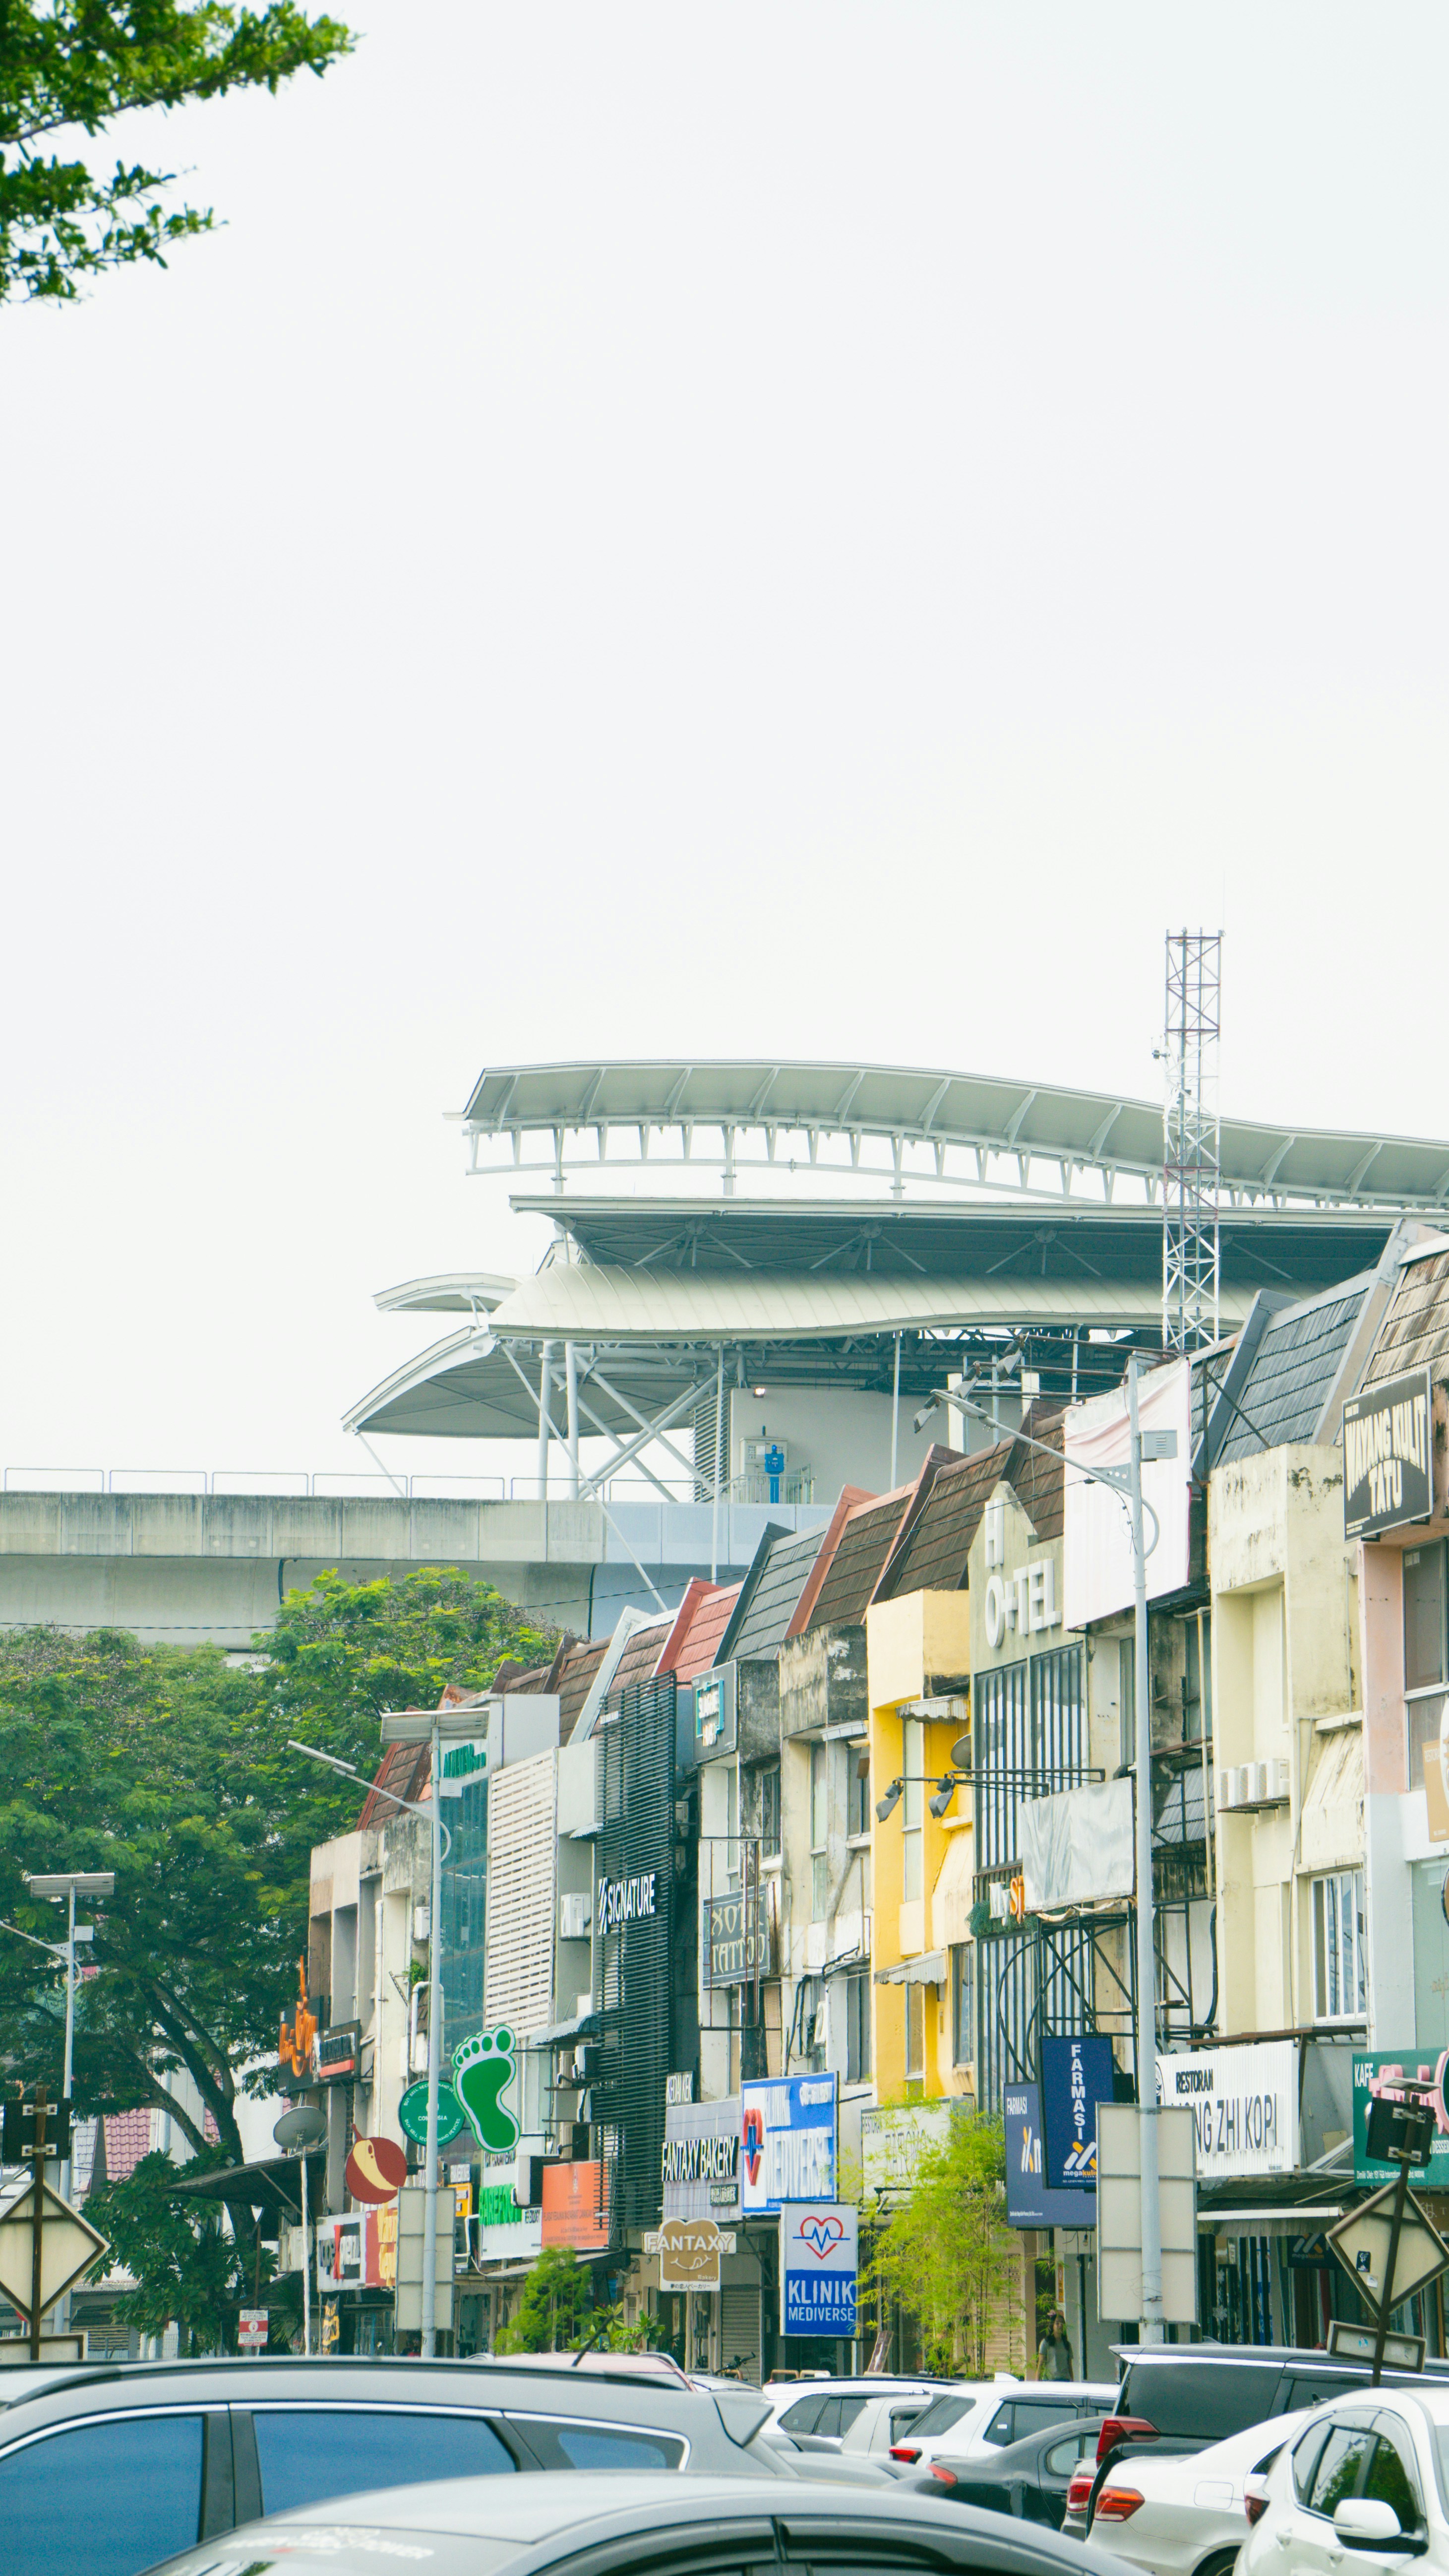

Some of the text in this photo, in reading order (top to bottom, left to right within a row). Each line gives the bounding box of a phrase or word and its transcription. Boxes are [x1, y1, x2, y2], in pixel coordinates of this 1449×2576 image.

[1345, 1394, 1426, 1502] WAYANG KULIT
[1369, 1459, 1402, 1516] TATU
[608, 1874, 655, 1924] SIGNATURE
[712, 1933, 765, 1974] TATTOO
[666, 2073, 692, 2103] KEDAI KEK
[1071, 2044, 1086, 2140] FARMASI
[1176, 2069, 1213, 2094] RESTORAN
[1007, 2096, 1027, 2115] FARMASI
[1217, 2097, 1240, 2152] ZHI
[1245, 2093, 1277, 2149] KOPI
[662, 2136, 735, 2182] FANTAXY BAKERY
[647, 2234, 734, 2252] FANTAXY
[788, 2280, 854, 2304] KLINIK
[788, 2307, 855, 2322] MEDIVERSE
